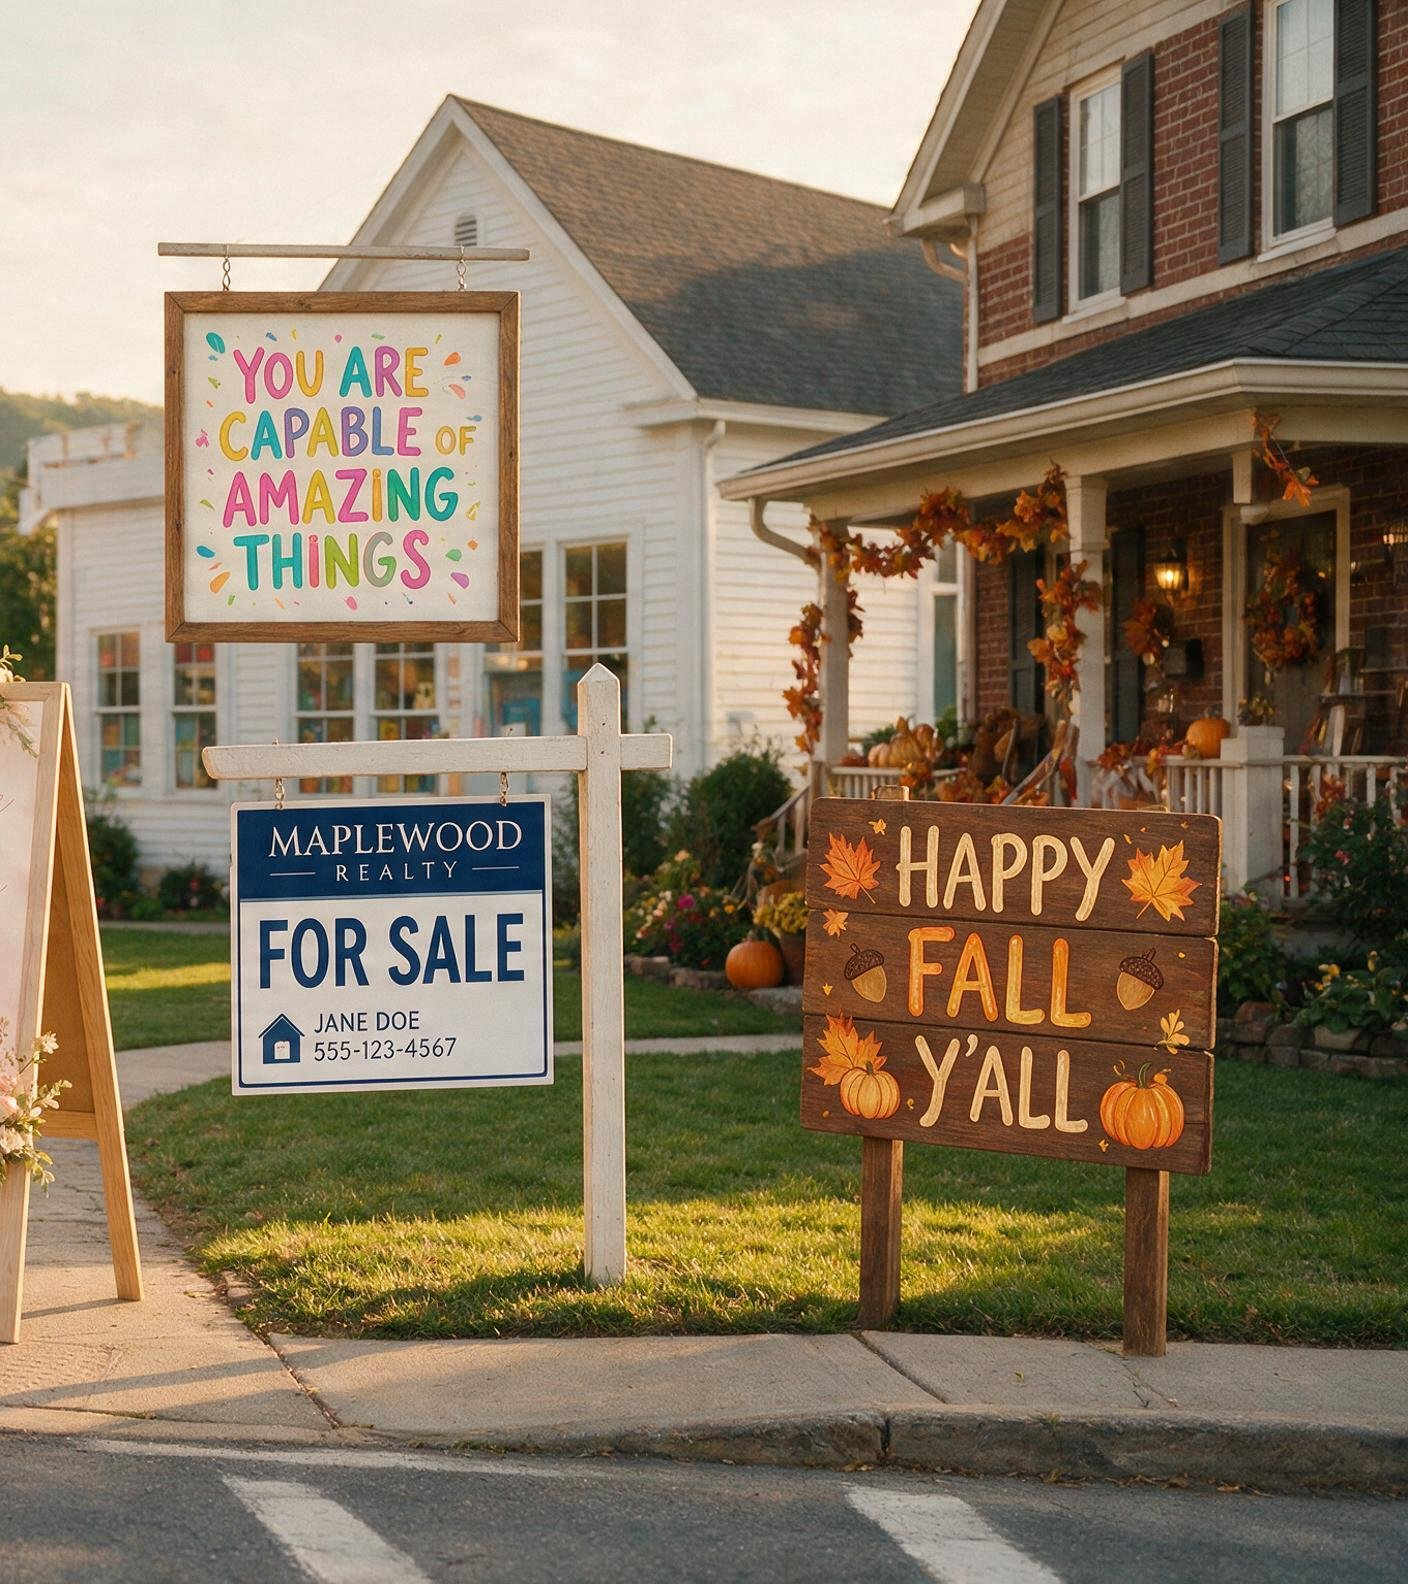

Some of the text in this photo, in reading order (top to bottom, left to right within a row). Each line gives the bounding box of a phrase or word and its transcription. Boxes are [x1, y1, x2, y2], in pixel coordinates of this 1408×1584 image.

[233, 345, 430, 404] YOU ARE
[218, 406, 477, 461] CAPABLE OF
[222, 466, 459, 528] AMAZING
[233, 529, 432, 591] THINGS
[268, 820, 522, 857] MAPLEWOOD
[336, 861, 459, 882] REALTY
[896, 825, 1115, 922] HAPPY
[259, 912, 525, 989] FOR SALE
[907, 926, 1092, 1028] FALL
[313, 1037, 457, 1062] 555-123-4567
[314, 1010, 420, 1034] JANE DOE
[915, 1034, 1089, 1133] Y'ALL
